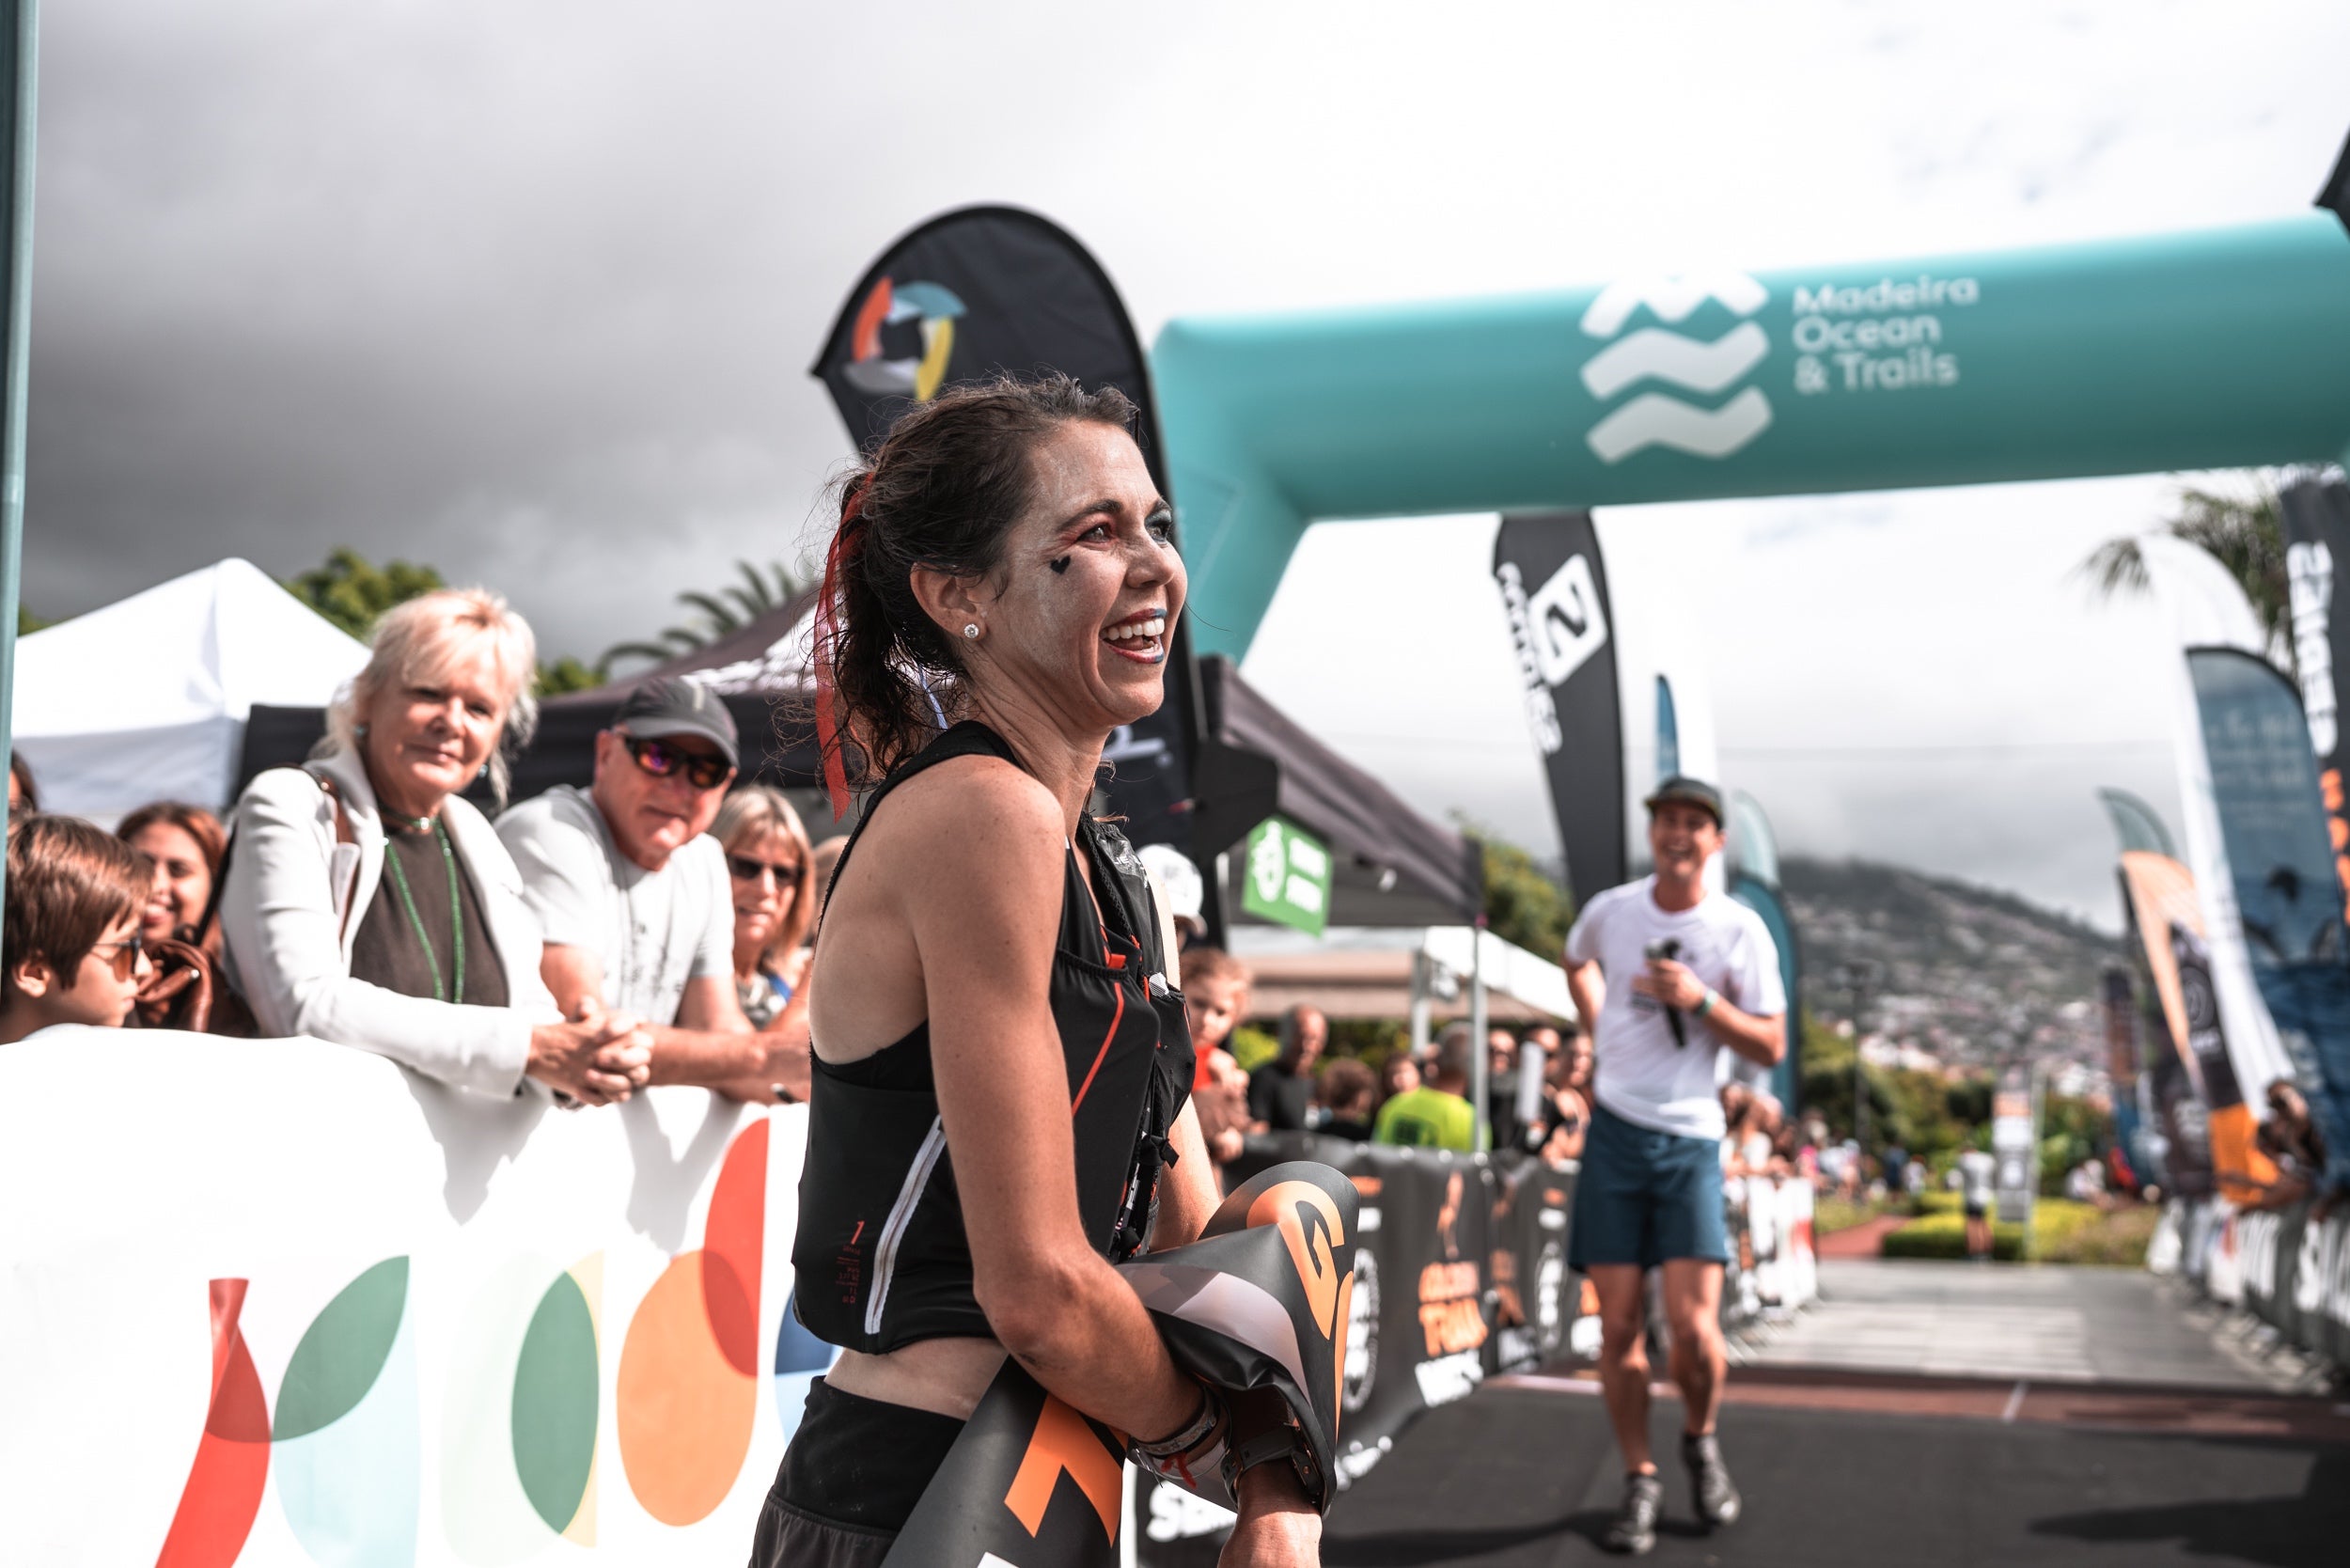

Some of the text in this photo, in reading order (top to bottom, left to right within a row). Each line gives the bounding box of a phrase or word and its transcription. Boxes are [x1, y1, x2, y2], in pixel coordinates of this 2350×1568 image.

[1793, 275, 1978, 315] Madeira
[1793, 315, 1939, 352] Ocean
[1794, 347, 1957, 395] & Trails
